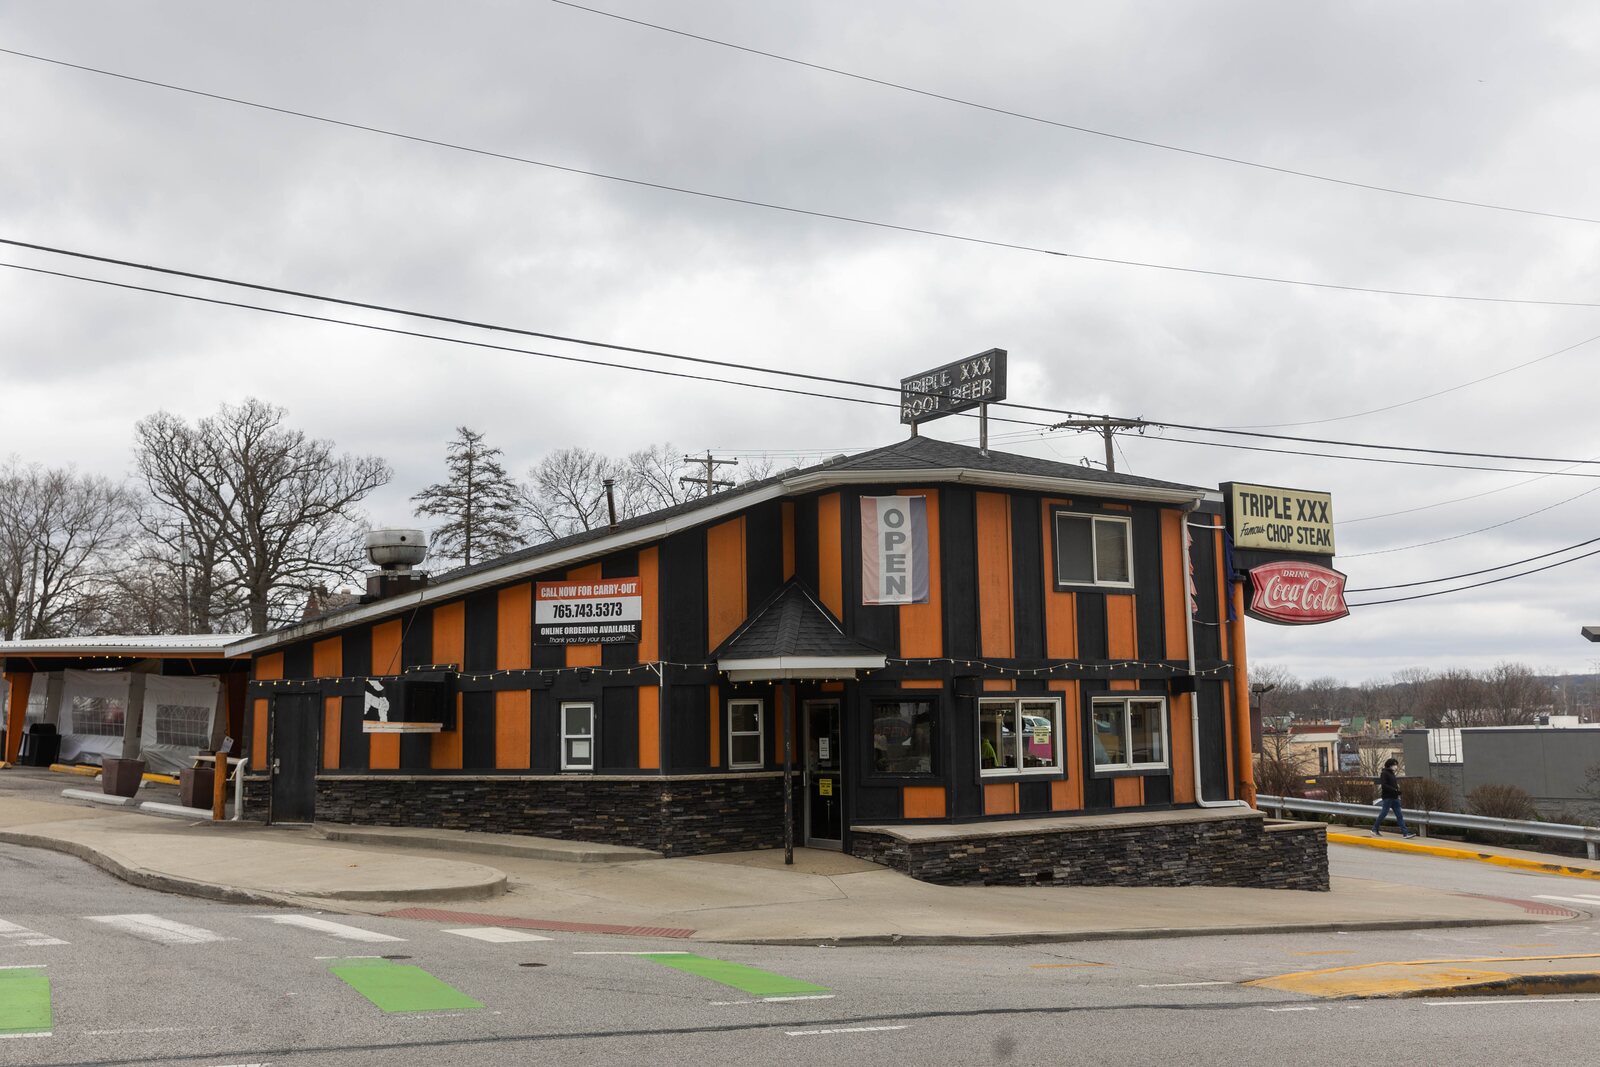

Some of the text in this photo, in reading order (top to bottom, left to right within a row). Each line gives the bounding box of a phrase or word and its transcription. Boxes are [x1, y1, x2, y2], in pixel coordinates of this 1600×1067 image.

[903, 356, 992, 398] TRIPLE XXX
[949, 378, 993, 405] BEER
[1239, 492, 1329, 524] TRIPLE XXX
[1239, 522, 1332, 547] Famous CHOP STEAK
[883, 508, 907, 595] OPEN
[1282, 569, 1310, 579] DRINK
[541, 583, 637, 598] CALL NOW FOR CARRY-OUT
[1263, 574, 1338, 612] Coca-Cola
[553, 602, 623, 618] 765.743.5373
[540, 624, 636, 635] ONLINE ORDERING AVAILABLE
